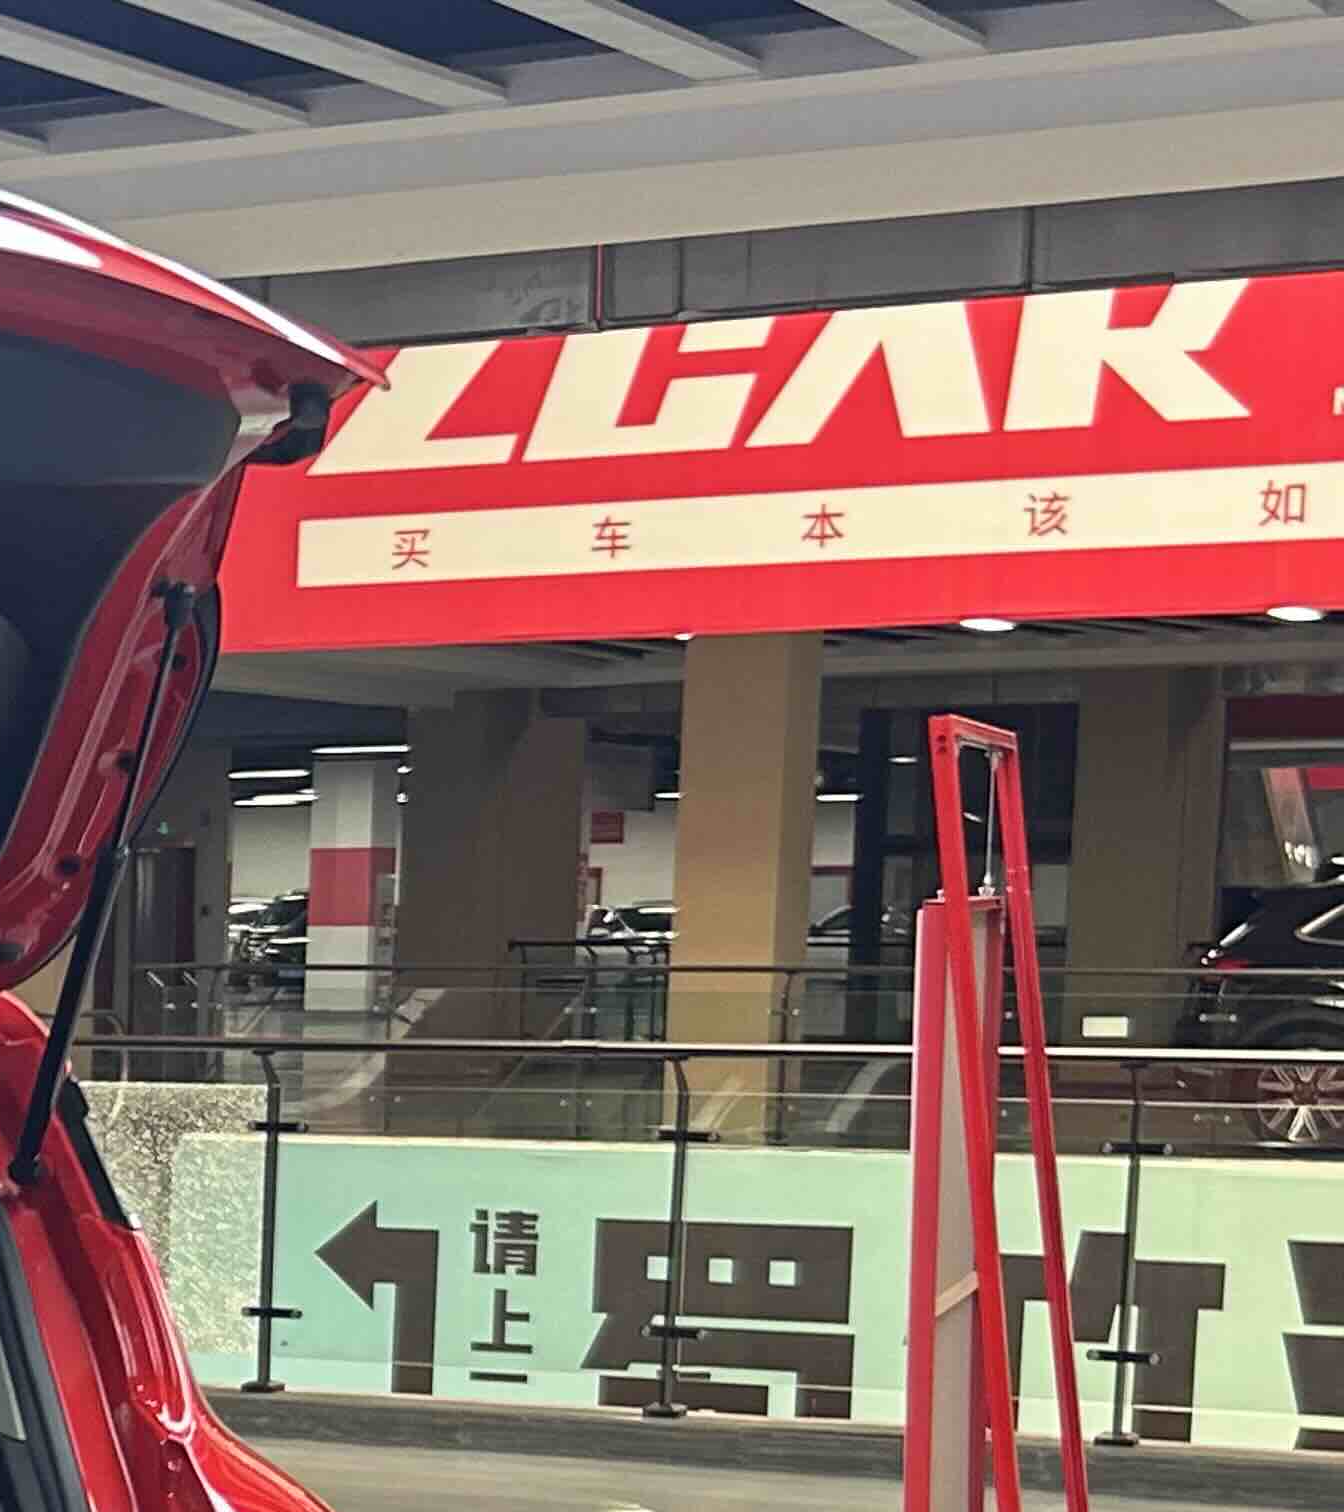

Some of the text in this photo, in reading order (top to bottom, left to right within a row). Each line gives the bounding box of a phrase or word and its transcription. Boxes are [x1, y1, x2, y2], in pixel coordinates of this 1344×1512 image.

[391, 480, 1307, 570] 买车本该如
[469, 1208, 540, 1385] 请上
